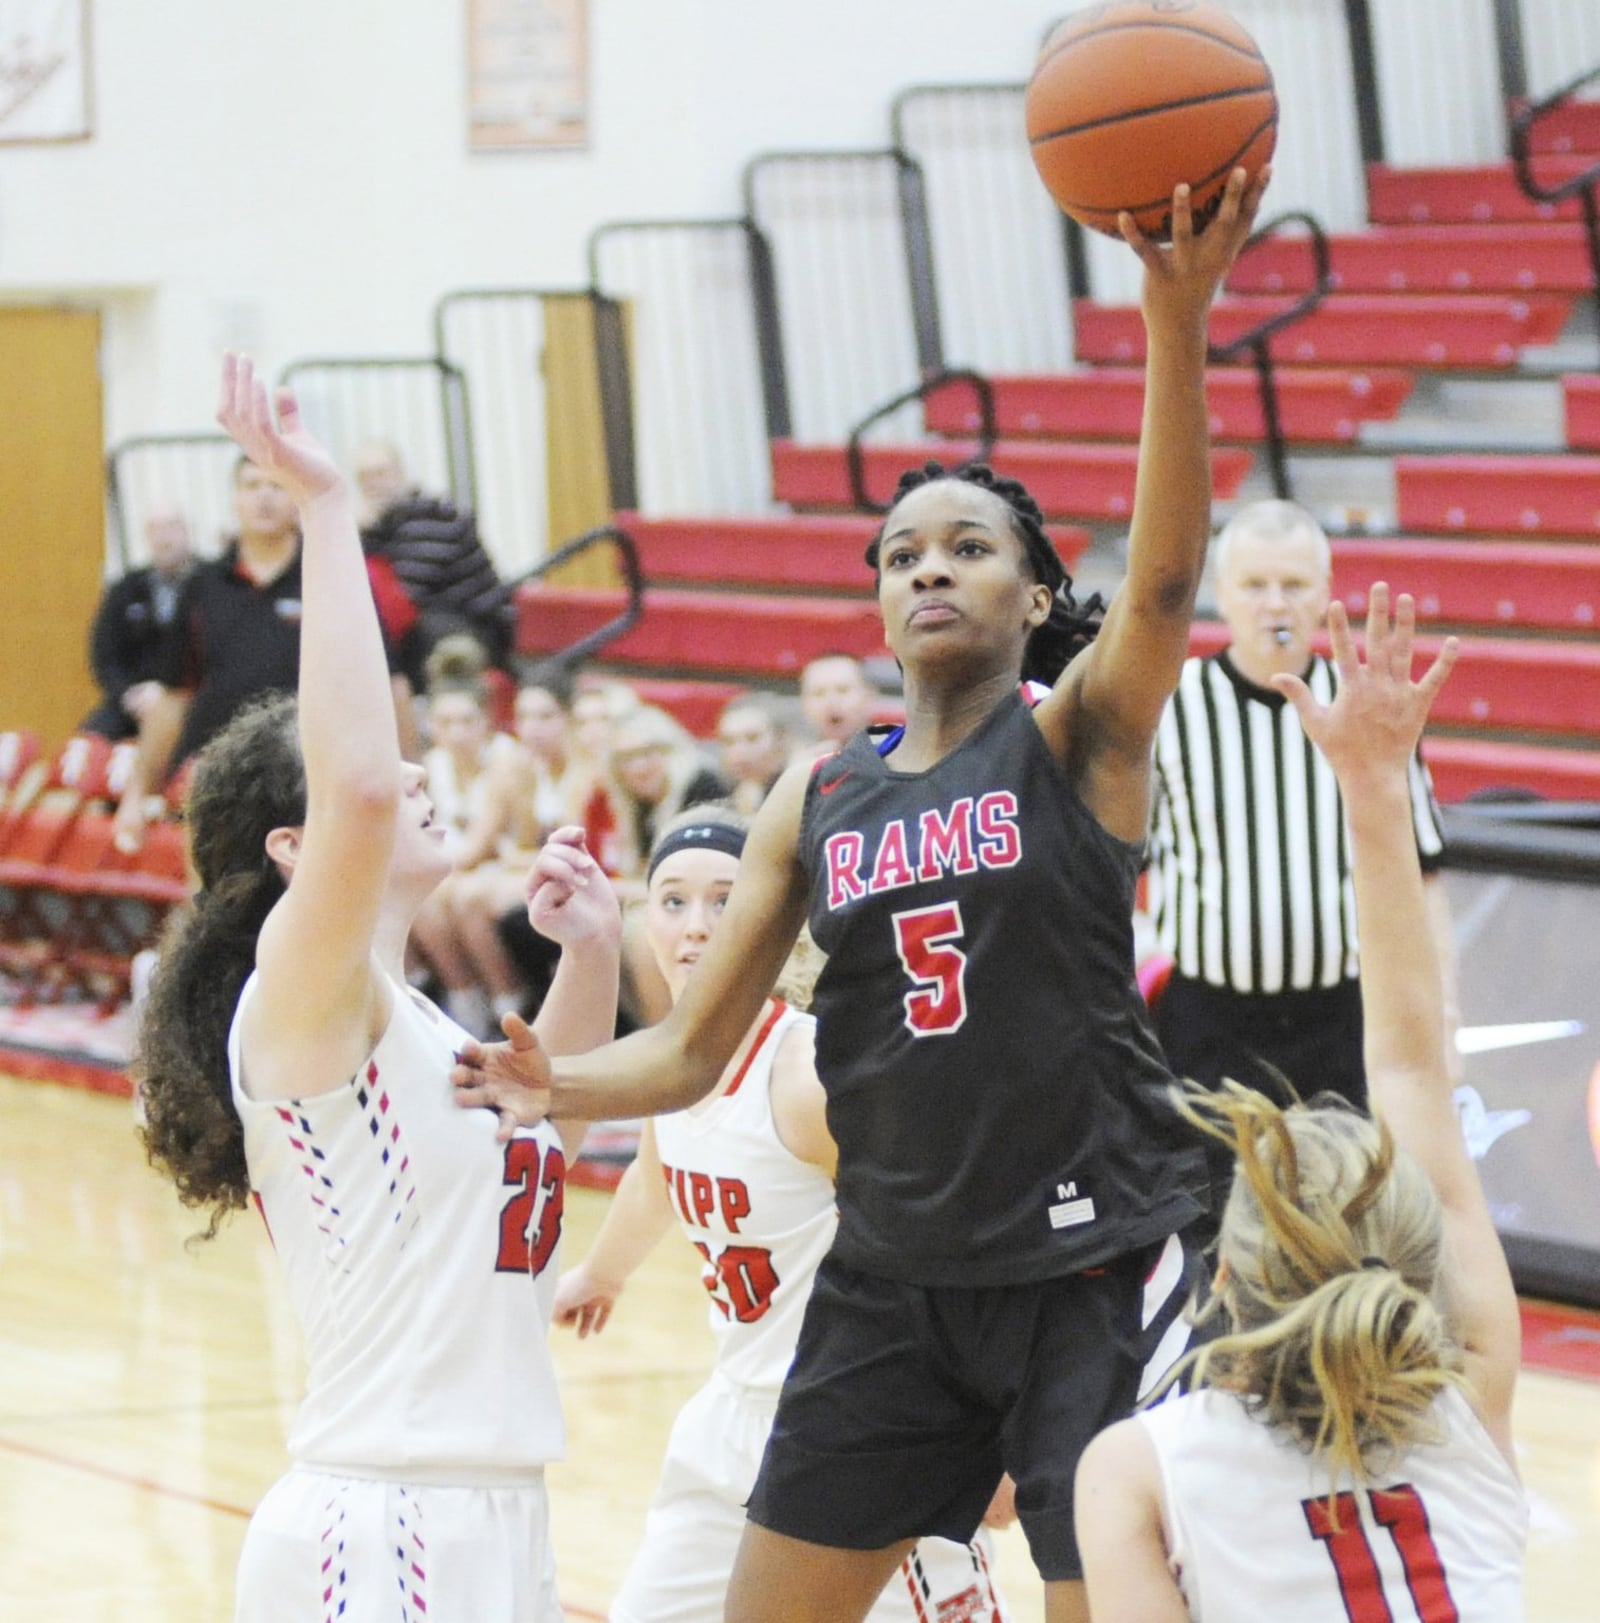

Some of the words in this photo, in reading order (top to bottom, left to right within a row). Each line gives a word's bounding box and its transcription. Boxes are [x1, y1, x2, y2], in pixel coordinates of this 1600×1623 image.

[824, 790, 1022, 910] RAMS
[891, 900, 967, 1037] 5
[495, 1137, 566, 1280] 23
[1057, 1181, 1078, 1200] M
[1300, 1482, 1459, 1623] 11
